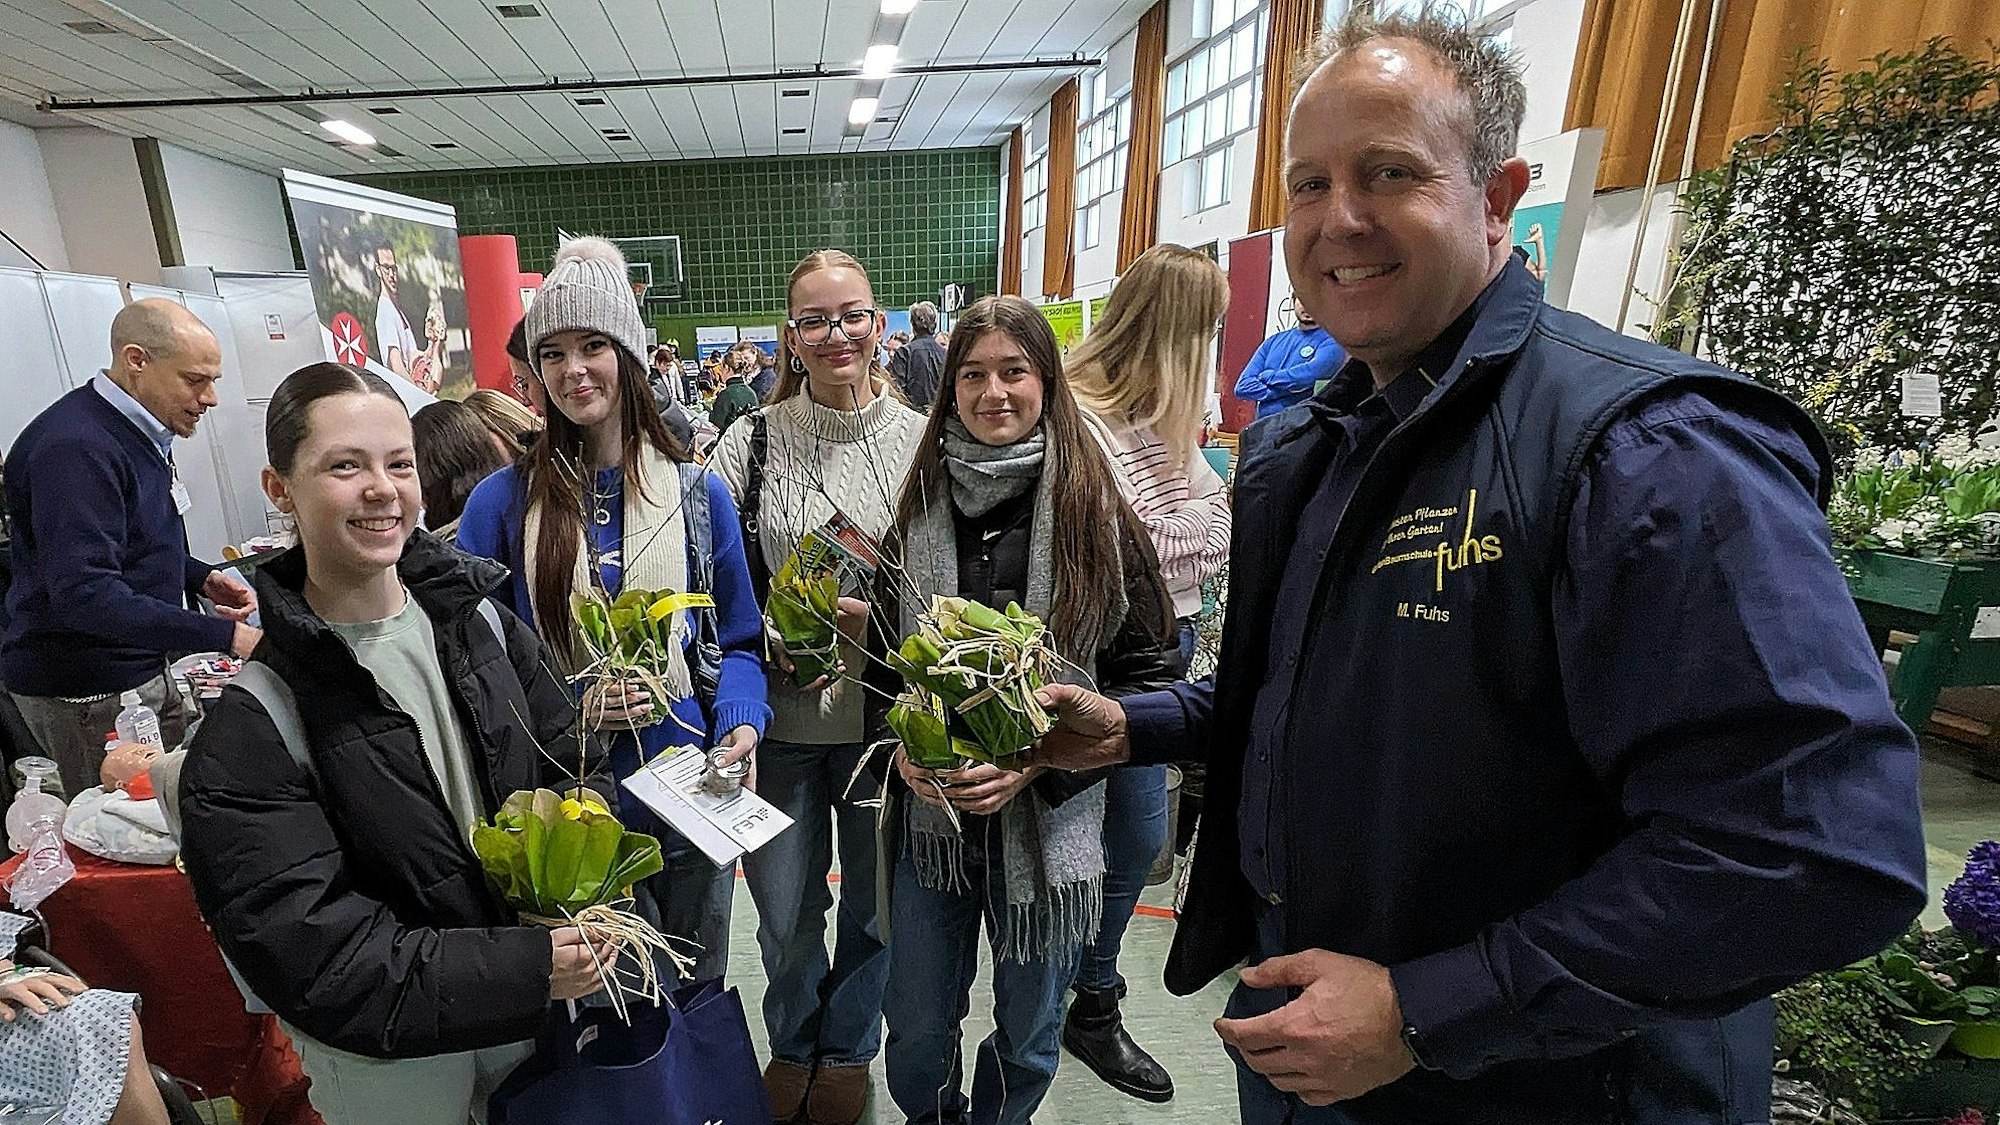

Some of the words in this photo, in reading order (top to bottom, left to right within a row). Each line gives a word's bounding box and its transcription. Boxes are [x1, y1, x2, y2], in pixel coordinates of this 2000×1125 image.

[1436, 488, 1503, 592] fuhs
[1397, 603, 1410, 617] M.
[1415, 604, 1450, 622] Fuhs
